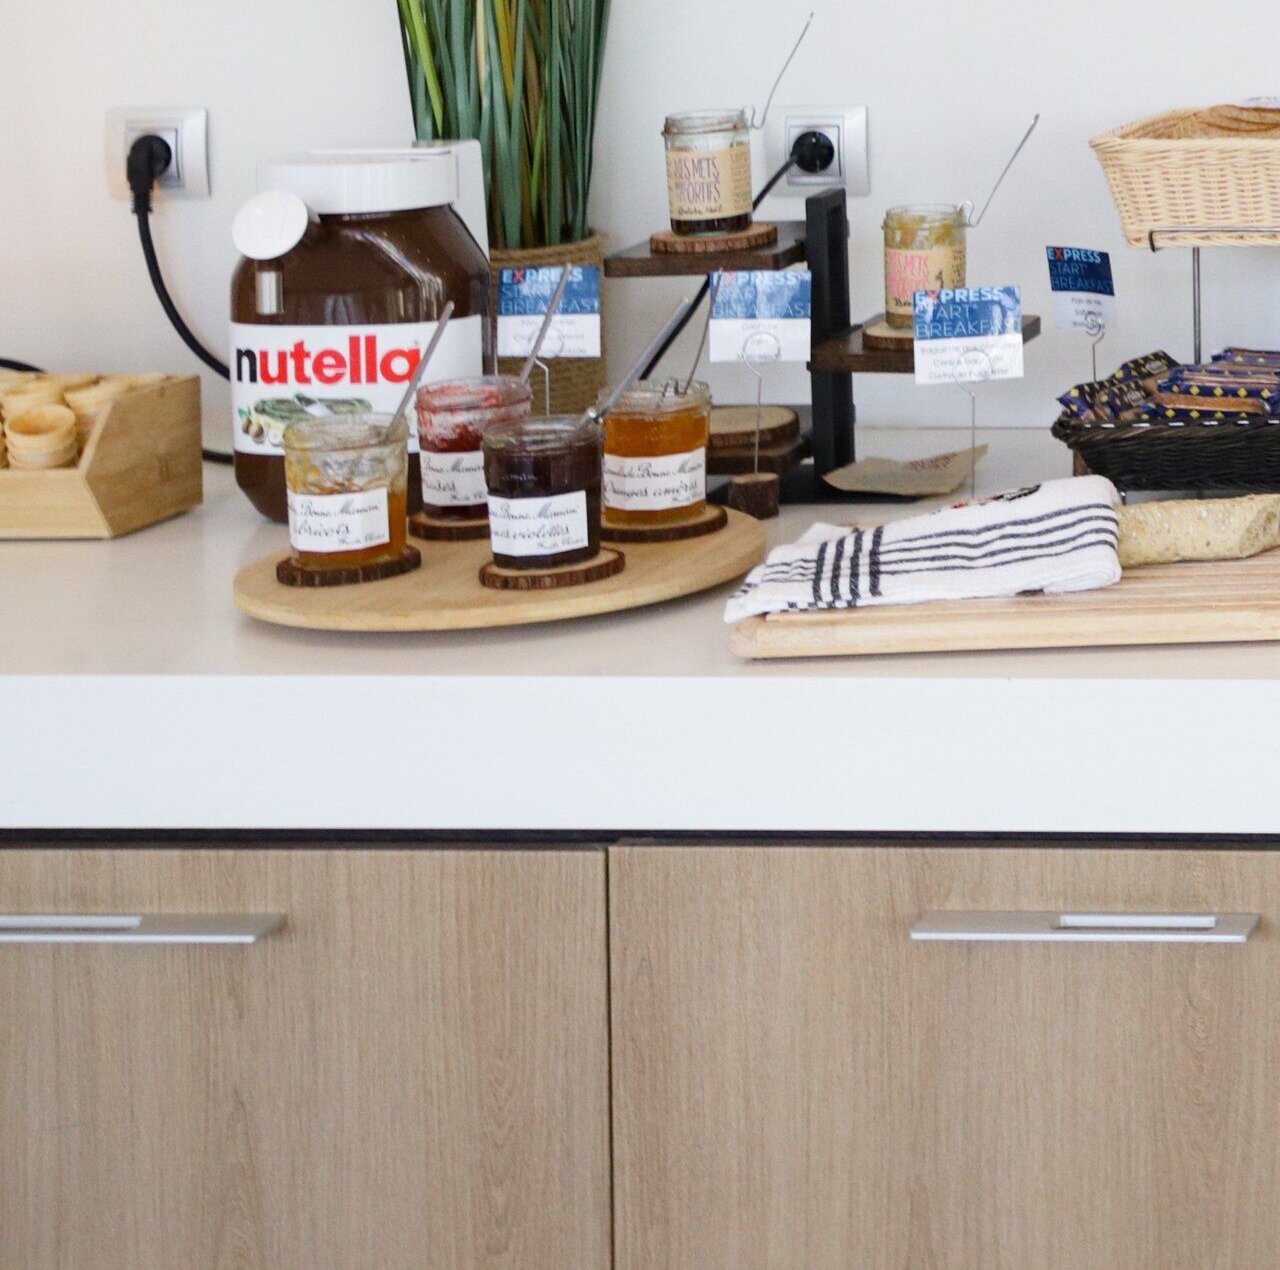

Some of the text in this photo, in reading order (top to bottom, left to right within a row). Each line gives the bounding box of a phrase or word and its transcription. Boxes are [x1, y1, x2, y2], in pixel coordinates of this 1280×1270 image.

[1047, 247, 1102, 263] EXPRESS
[915, 287, 1004, 306] EXPRESS
[236, 334, 422, 385] nutella
